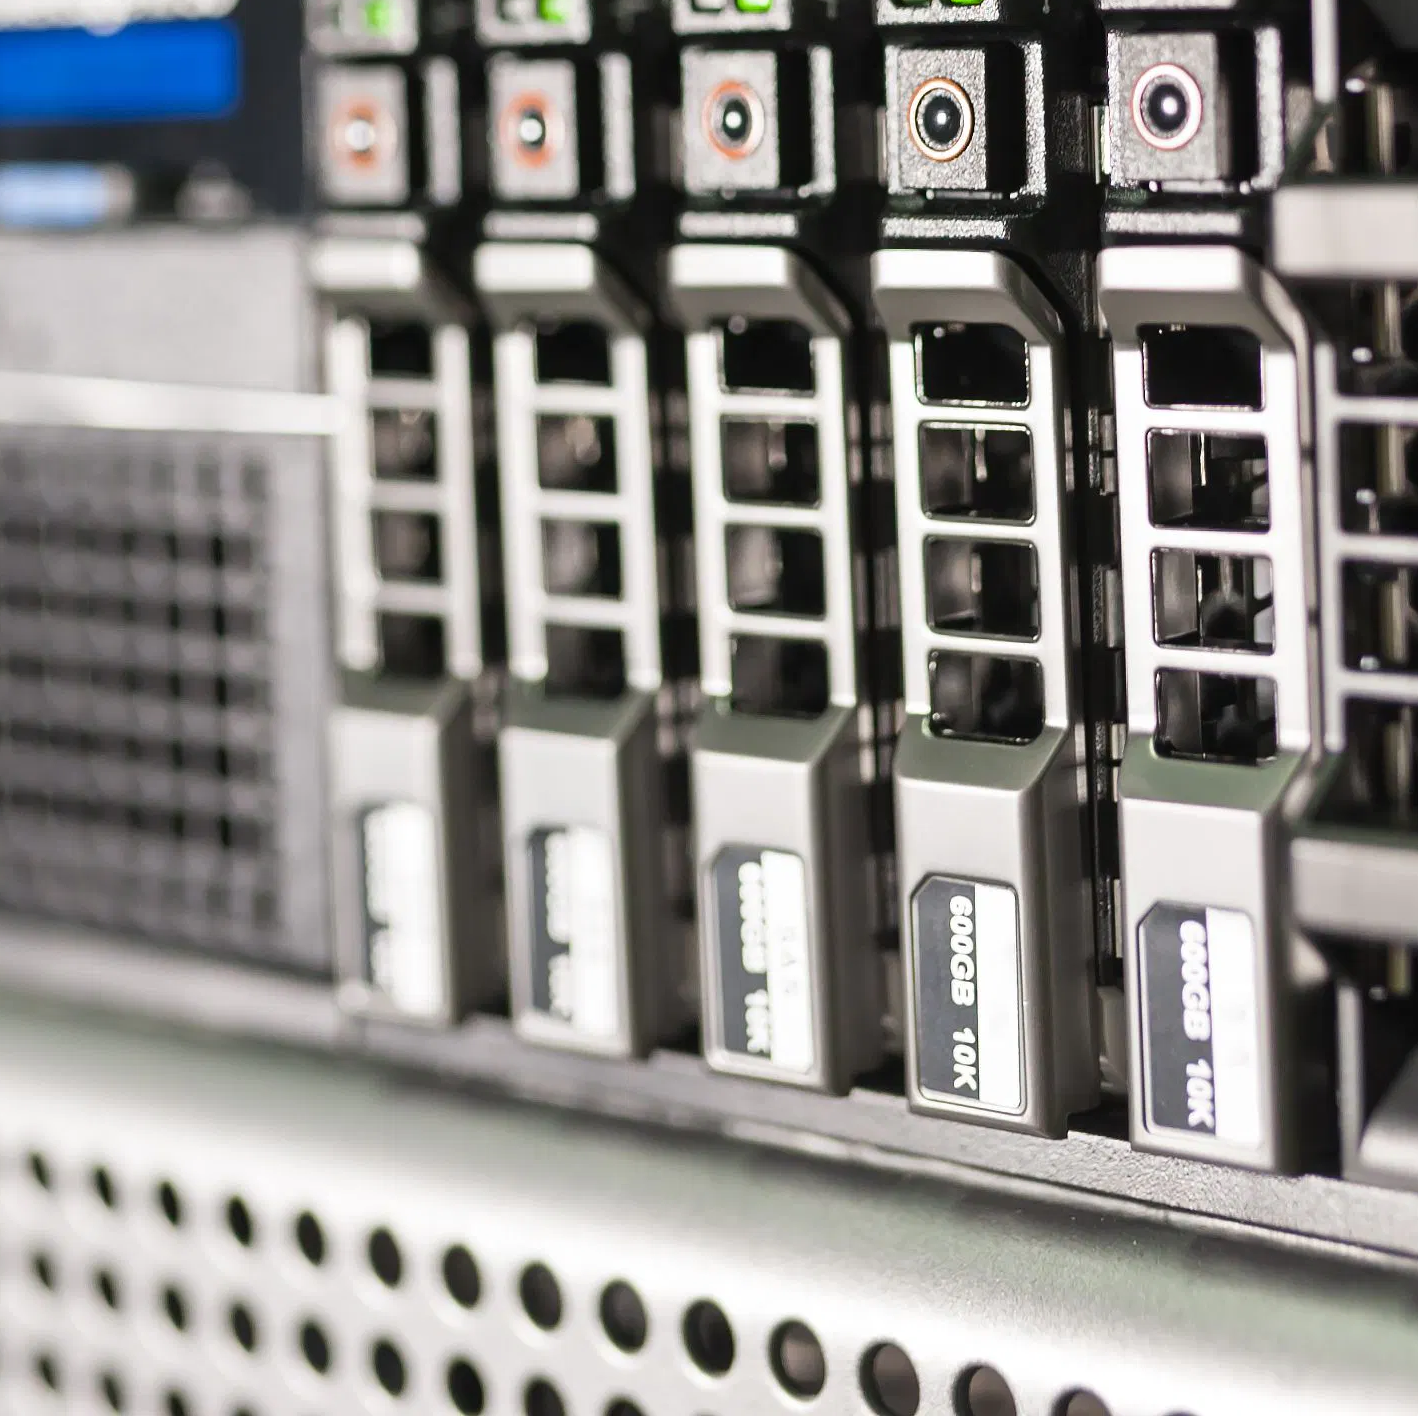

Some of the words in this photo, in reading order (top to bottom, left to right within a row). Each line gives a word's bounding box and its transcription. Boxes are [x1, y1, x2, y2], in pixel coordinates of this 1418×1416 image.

[949, 895, 975, 1007] 600GB
[1180, 920, 1211, 1041] 600GB
[952, 1027, 978, 1092] 10K
[1186, 1058, 1215, 1129] 10K
